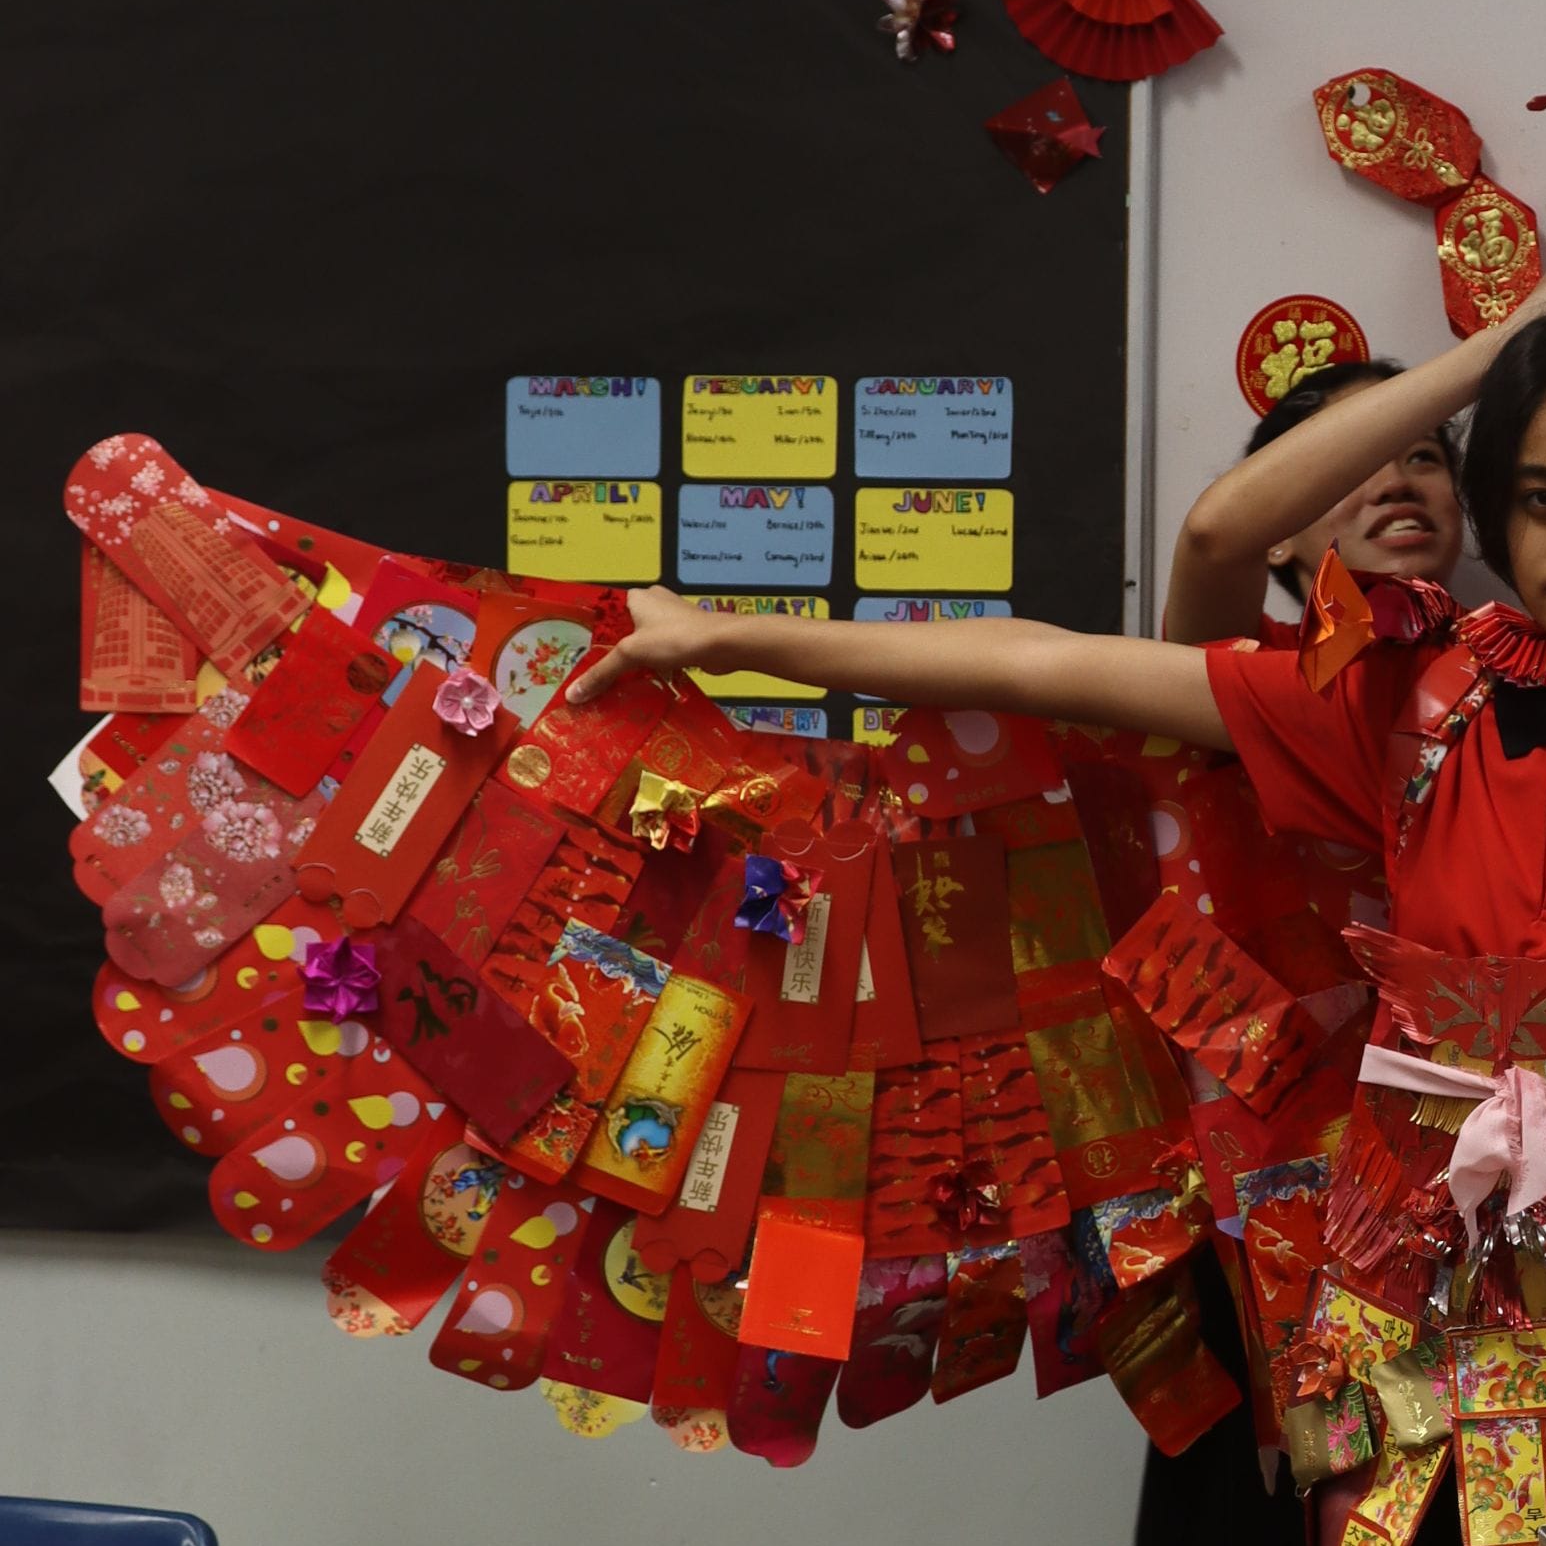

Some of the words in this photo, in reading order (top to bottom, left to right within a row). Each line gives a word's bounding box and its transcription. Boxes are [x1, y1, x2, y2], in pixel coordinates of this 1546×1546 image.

[1459, 207, 1516, 269] 福
[528, 376, 646, 397] MARCH!
[694, 377, 825, 395] FEBUARY!
[865, 378, 1005, 396] JANUARY!
[530, 482, 640, 503] APRIL!
[720, 486, 806, 509] MAY!
[893, 489, 986, 513] JUNE!
[884, 600, 985, 621] JULY!
[365, 755, 435, 845] 新年快乐
[688, 1110, 730, 1202] 新年快乐
